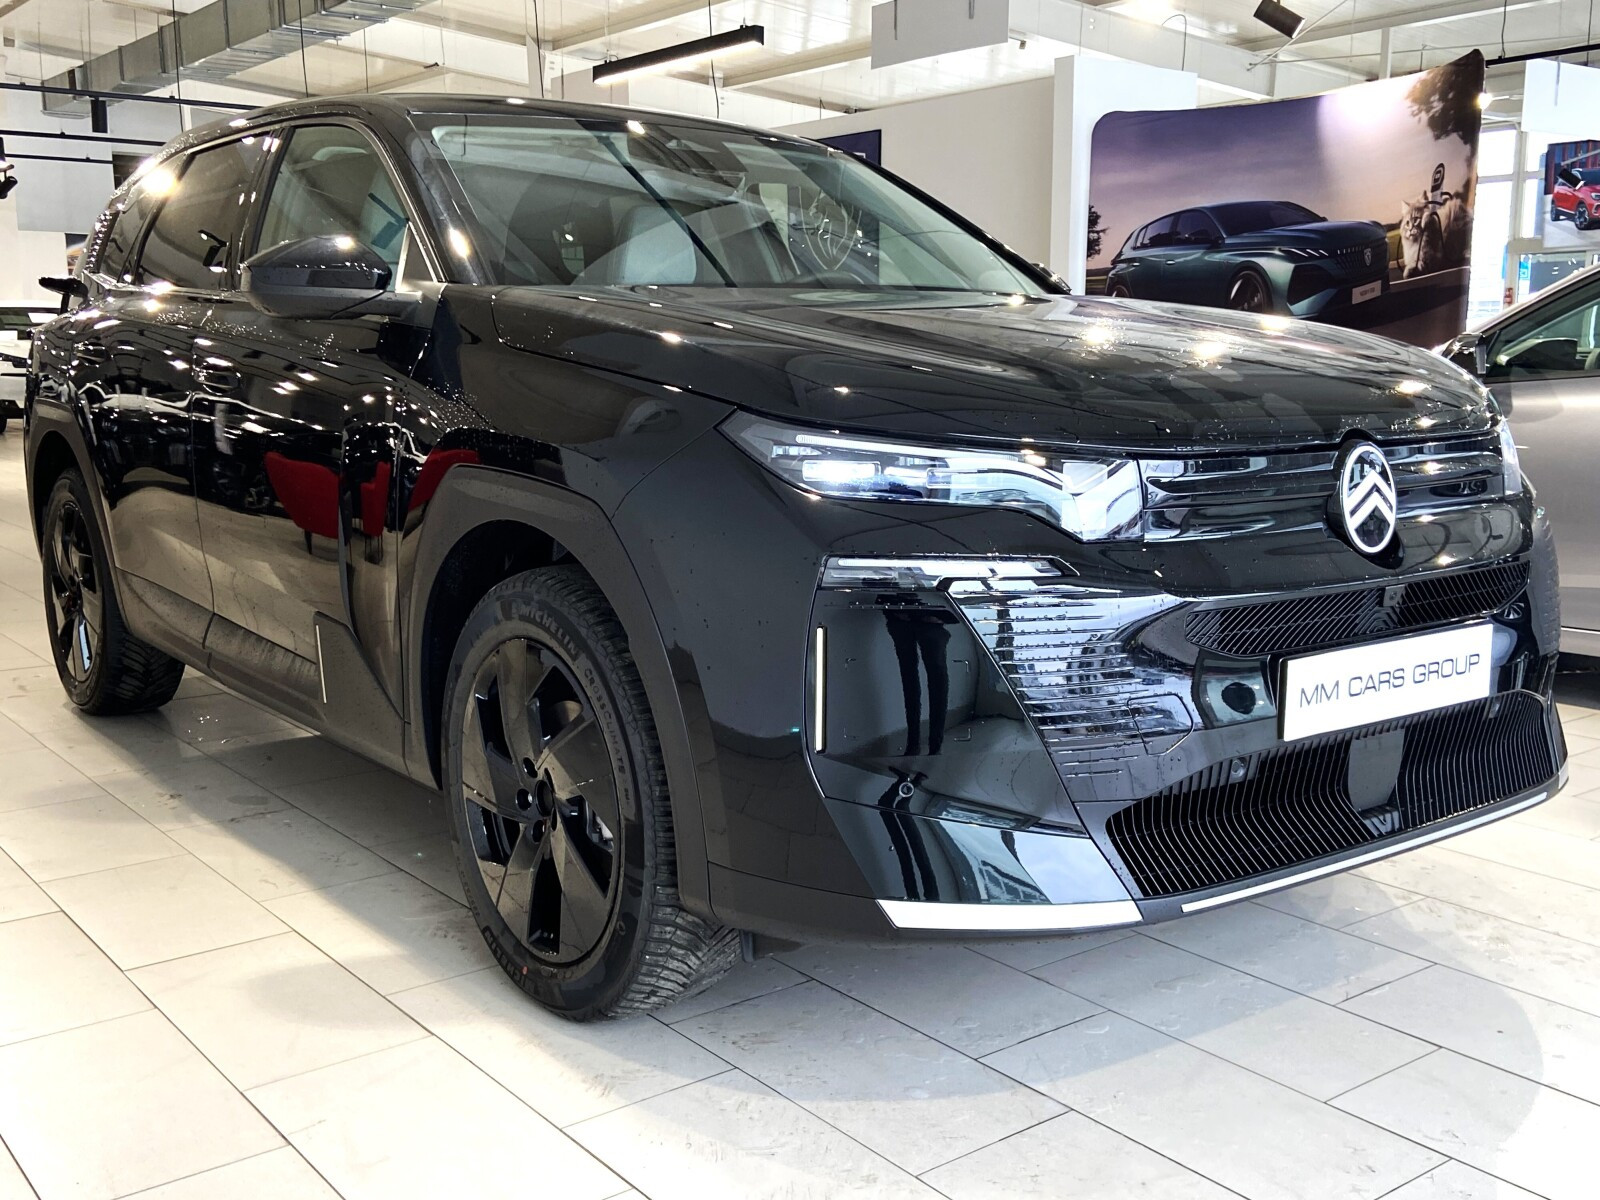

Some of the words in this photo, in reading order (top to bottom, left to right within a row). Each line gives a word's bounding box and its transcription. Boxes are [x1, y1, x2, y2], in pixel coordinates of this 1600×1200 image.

[519, 604, 579, 656] MICHELIN
[1300, 680, 1339, 708] MM
[1348, 668, 1405, 697] CARS
[1412, 653, 1480, 684] GROUP
